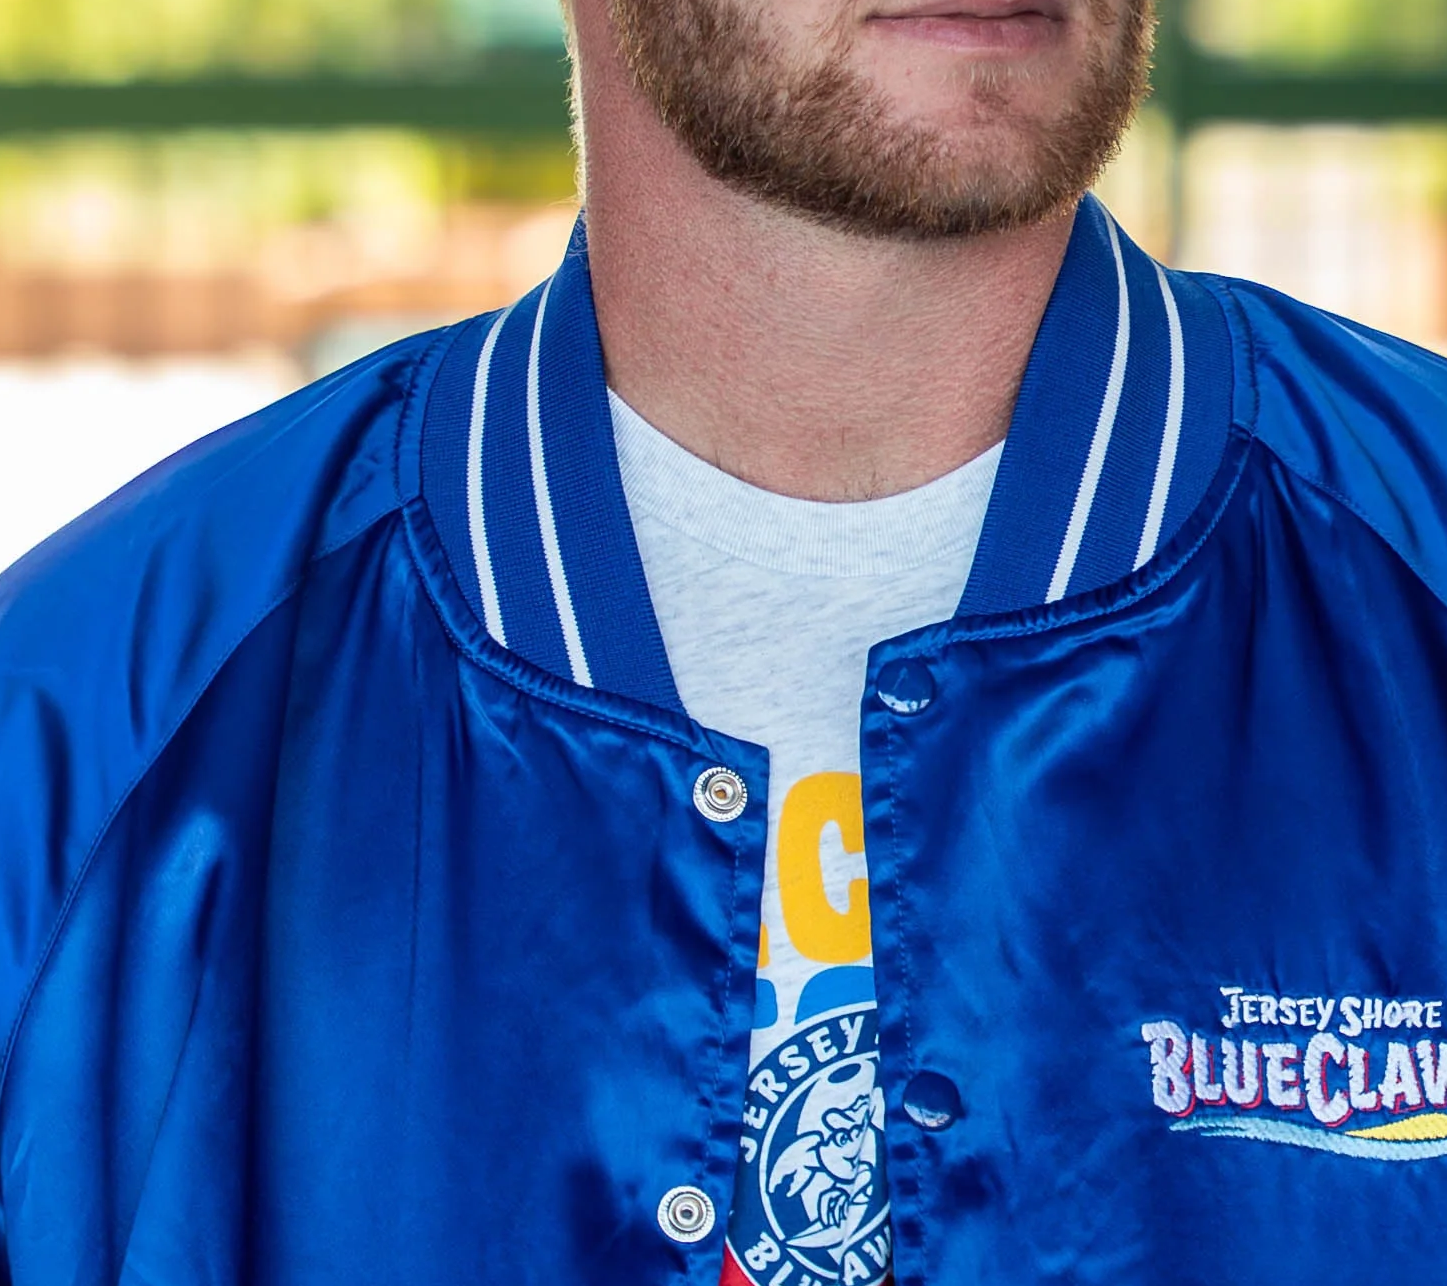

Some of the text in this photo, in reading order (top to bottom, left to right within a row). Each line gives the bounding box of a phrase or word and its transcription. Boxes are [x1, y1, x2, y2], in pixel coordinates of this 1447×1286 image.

[1219, 986, 1443, 1037] JERSEY SHORE
[740, 1015, 865, 1164] JERSEY
